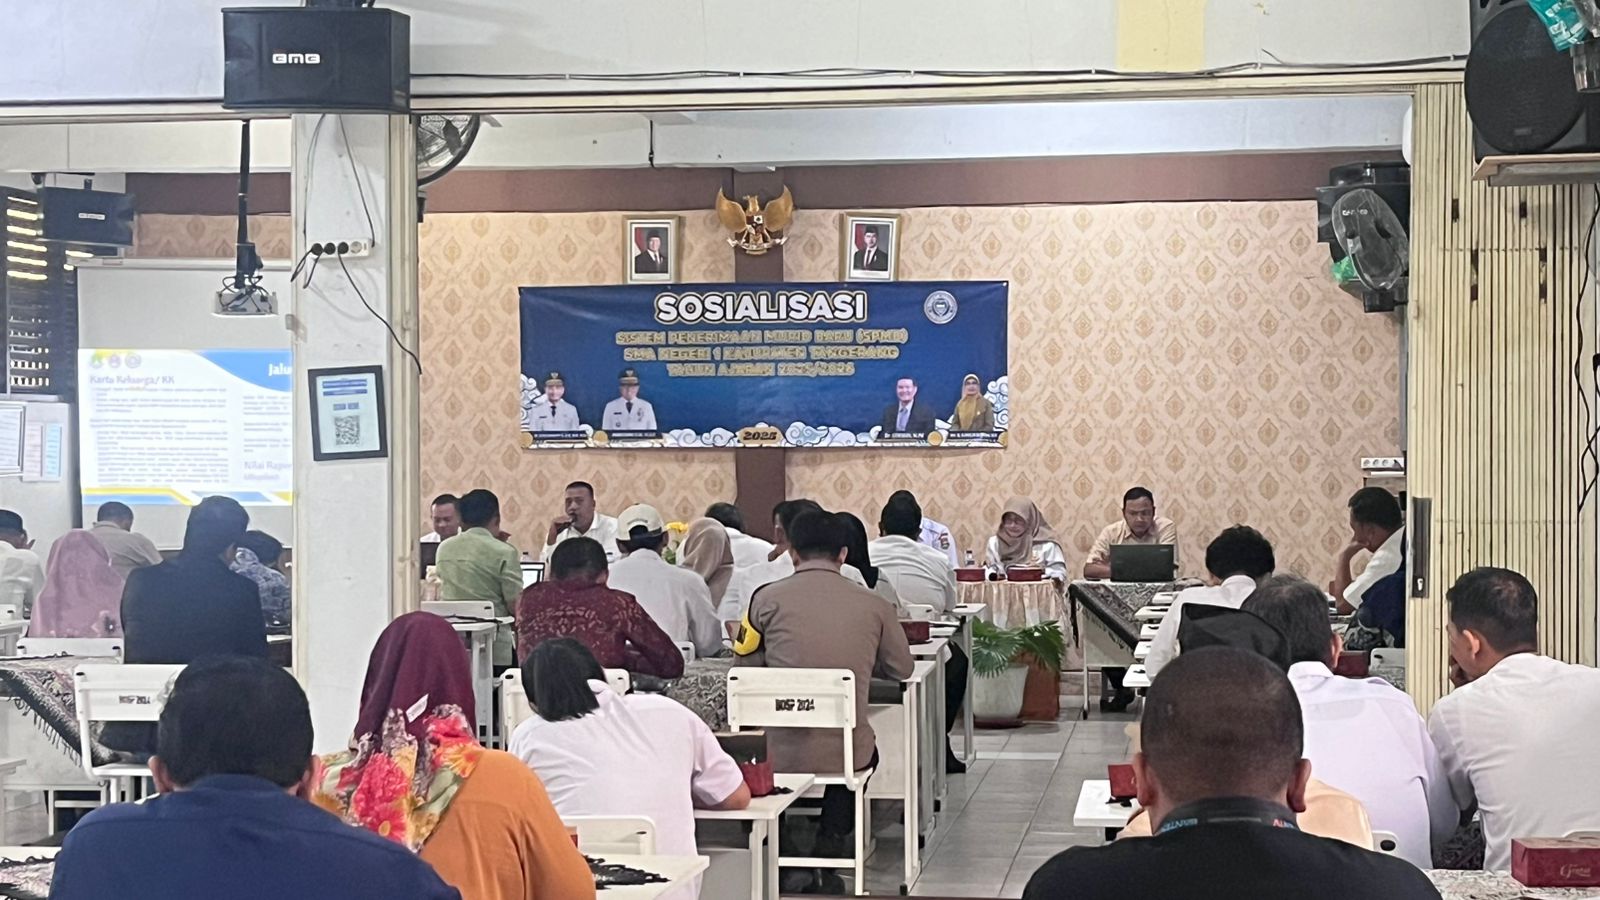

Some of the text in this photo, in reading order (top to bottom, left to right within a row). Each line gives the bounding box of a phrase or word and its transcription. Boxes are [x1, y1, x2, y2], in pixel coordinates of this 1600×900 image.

[656, 292, 866, 323] SOSIALISASI
[616, 331, 666, 345] SISTEM
[668, 330, 762, 345] PENERIMAAN
[764, 330, 812, 344] MURID
[814, 329, 854, 344] BARU
[624, 347, 657, 361] SMA
[658, 347, 711, 361] NEGERI
[723, 346, 807, 360] KABUPATEN
[808, 345, 900, 359] TANGERANG
[666, 363, 716, 376] TAHUN
[717, 363, 776, 376] AJARAN
[742, 431, 778, 442] 2025
